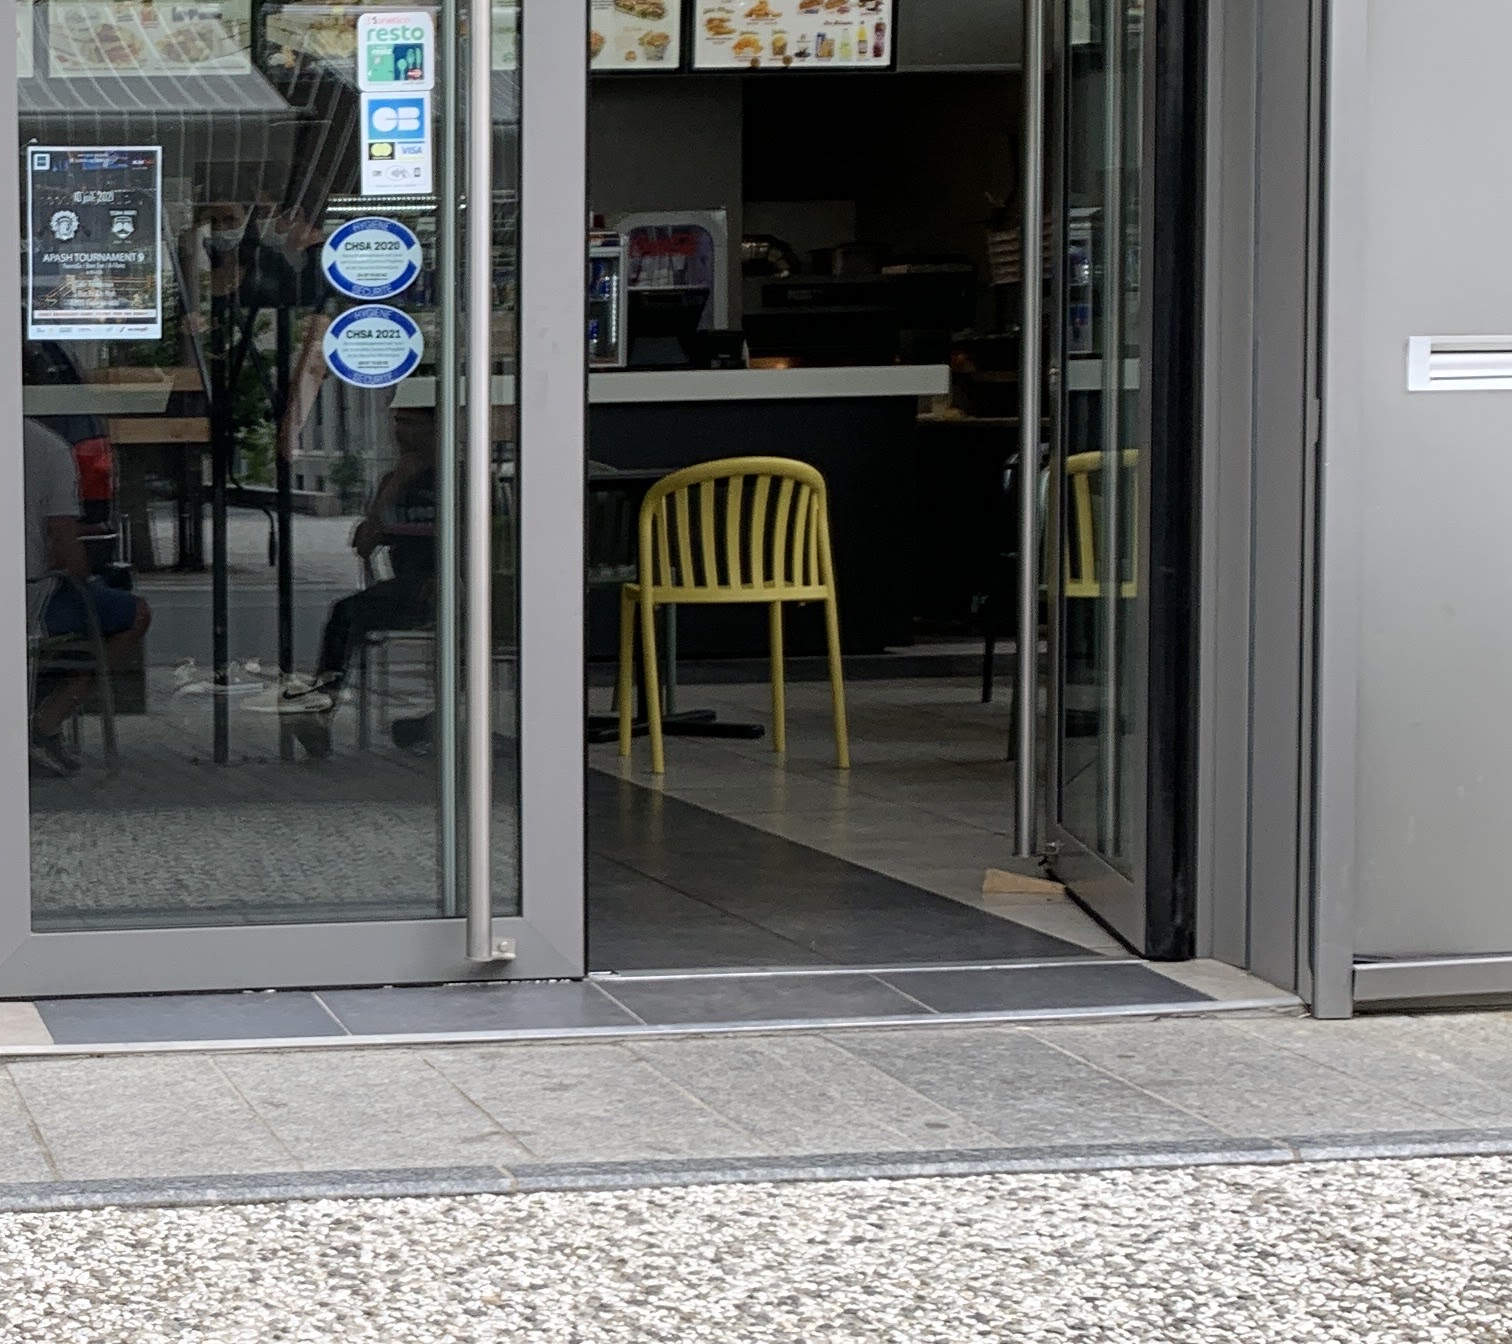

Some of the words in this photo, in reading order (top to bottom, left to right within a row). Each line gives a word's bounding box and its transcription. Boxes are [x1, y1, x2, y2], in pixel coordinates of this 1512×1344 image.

[367, 25, 425, 42] resto
[372, 107, 421, 132] CB
[401, 146, 423, 155] VISA
[344, 241, 373, 251] CHSA
[374, 241, 401, 251] 2020
[42, 253, 73, 263] APASH
[74, 253, 137, 263] TOURNAMENT
[345, 330, 374, 340] CHSA
[375, 330, 402, 340] 2021
